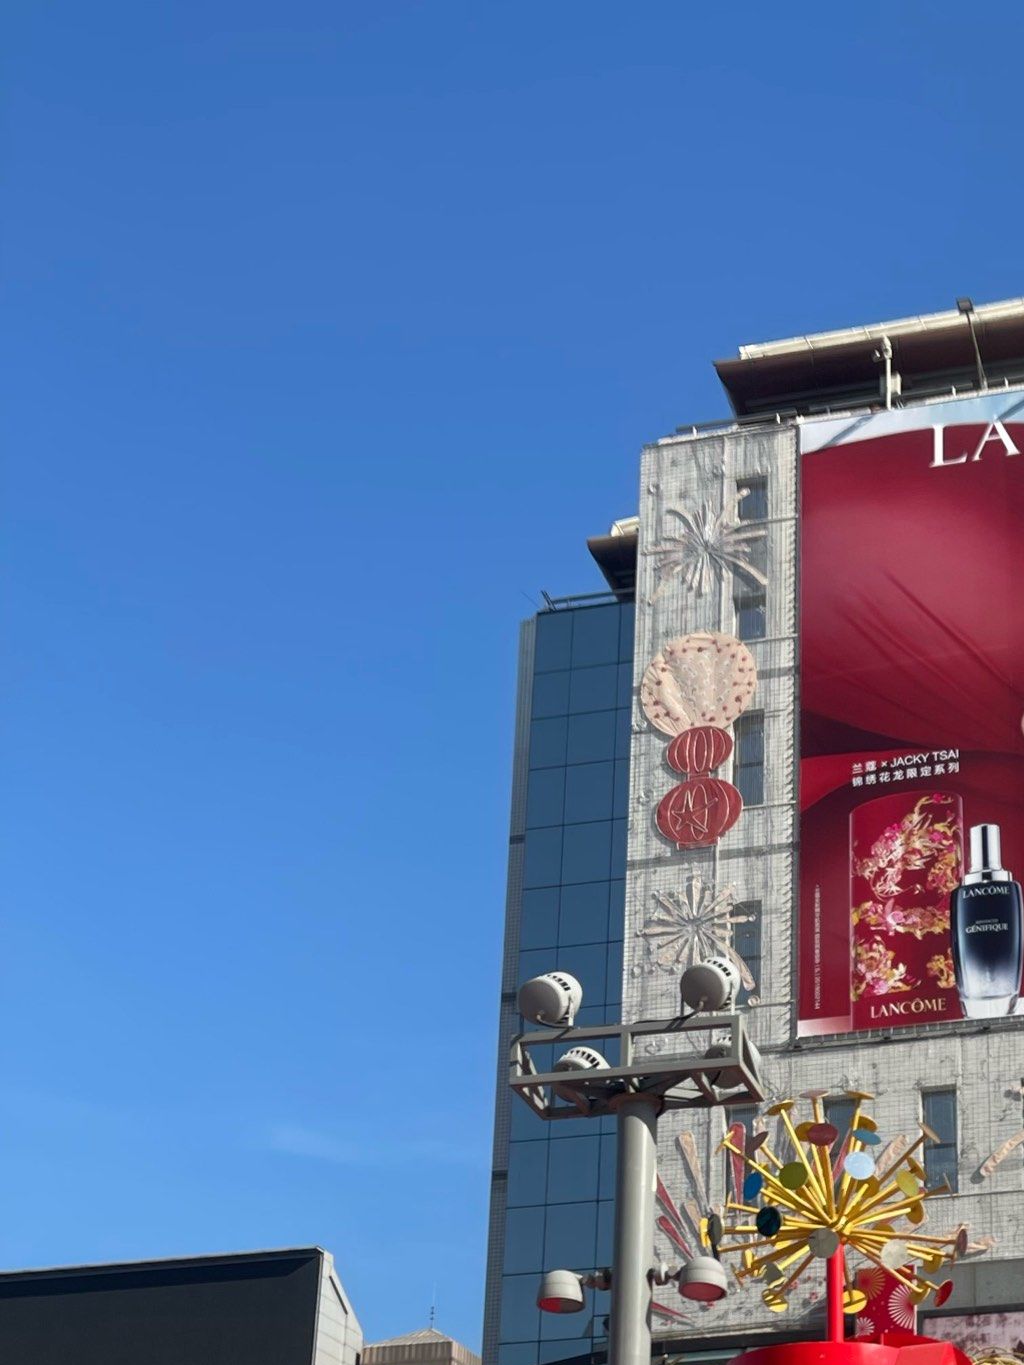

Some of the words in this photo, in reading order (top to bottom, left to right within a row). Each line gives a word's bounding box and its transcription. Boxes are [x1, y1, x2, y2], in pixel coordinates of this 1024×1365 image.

[852, 761, 877, 774] 兰蔻
[890, 753, 929, 768] JACKY
[932, 749, 959, 761] TSAI
[852, 762, 959, 787] 锦绣花龙限定系列
[870, 997, 947, 1019] LANCÔME
